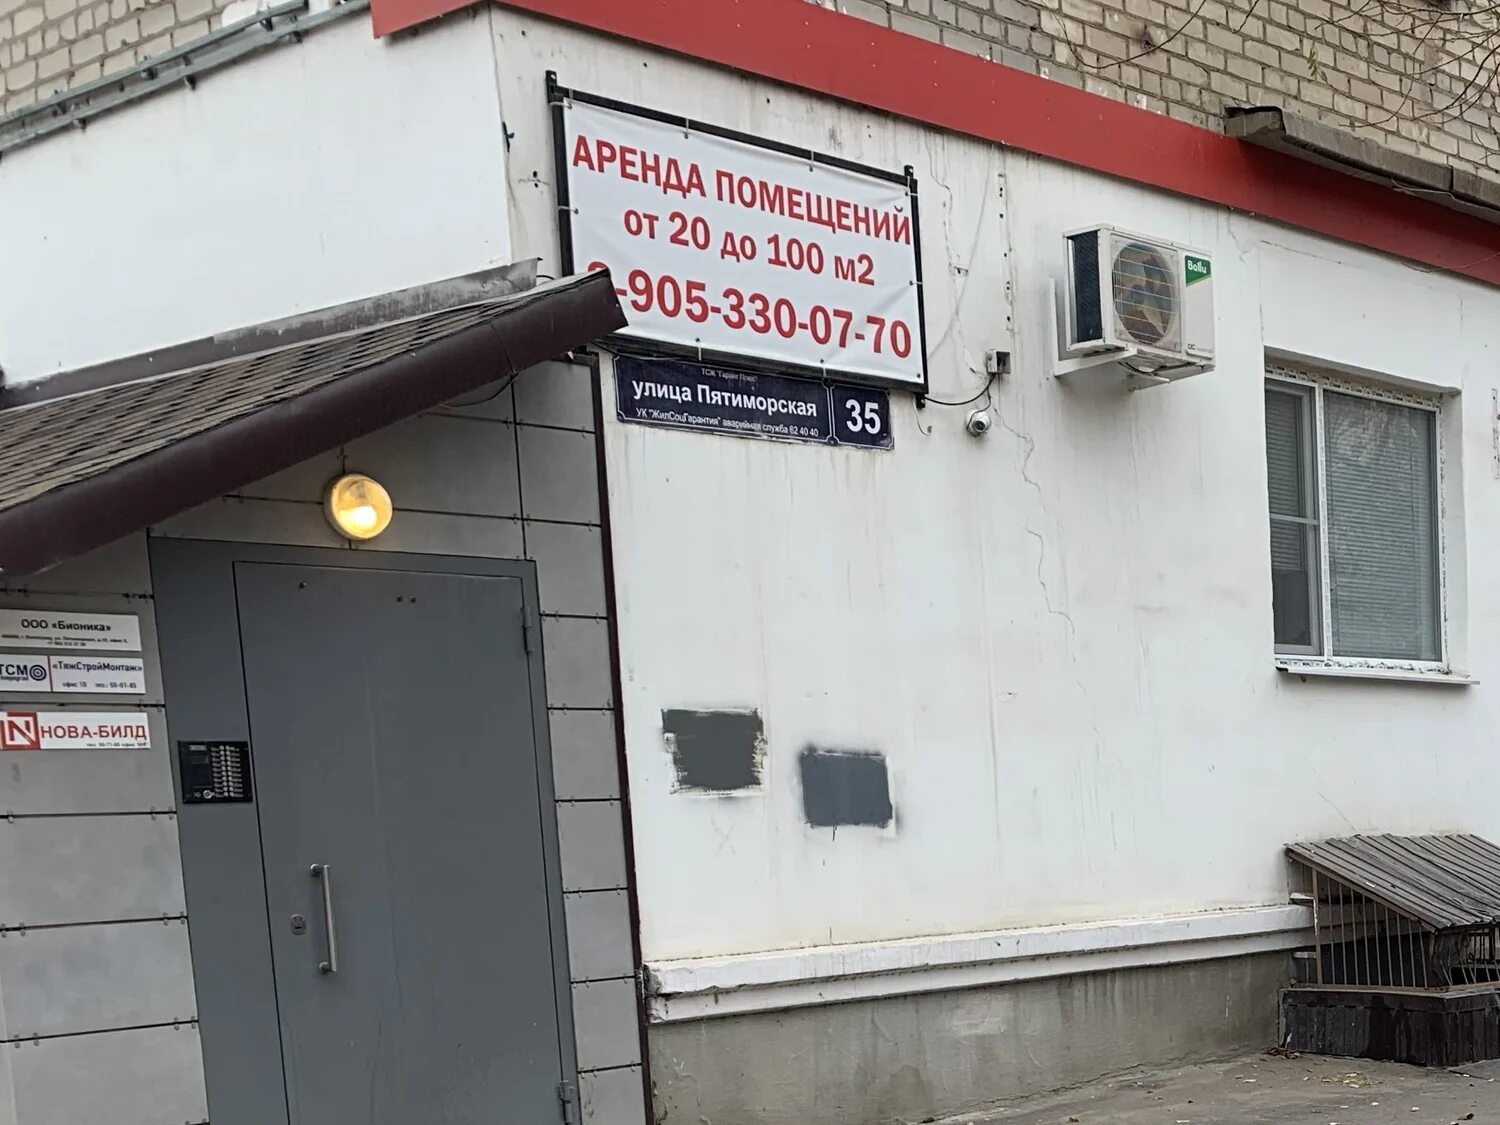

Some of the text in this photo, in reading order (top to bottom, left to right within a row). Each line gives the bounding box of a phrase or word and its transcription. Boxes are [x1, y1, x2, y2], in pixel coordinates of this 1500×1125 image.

[572, 134, 913, 246] АРЕНДА ПОМЕЩЕНИЙ
[624, 209, 876, 286] от 20 до 100 м2
[1187, 259, 1207, 274] Ballu
[587, 261, 912, 359] -905-330-07-70
[632, 380, 817, 417] улица Пятиморская
[636, 407, 648, 418] УК
[722, 418, 762, 431] аварийная
[762, 422, 788, 435] служба
[799, 427, 809, 437] 40
[810, 428, 819, 437] 40
[845, 399, 881, 434] 35
[21, 619, 111, 631] ООО «Бионика»
[41, 725, 147, 741] НОВА-БИЛД
